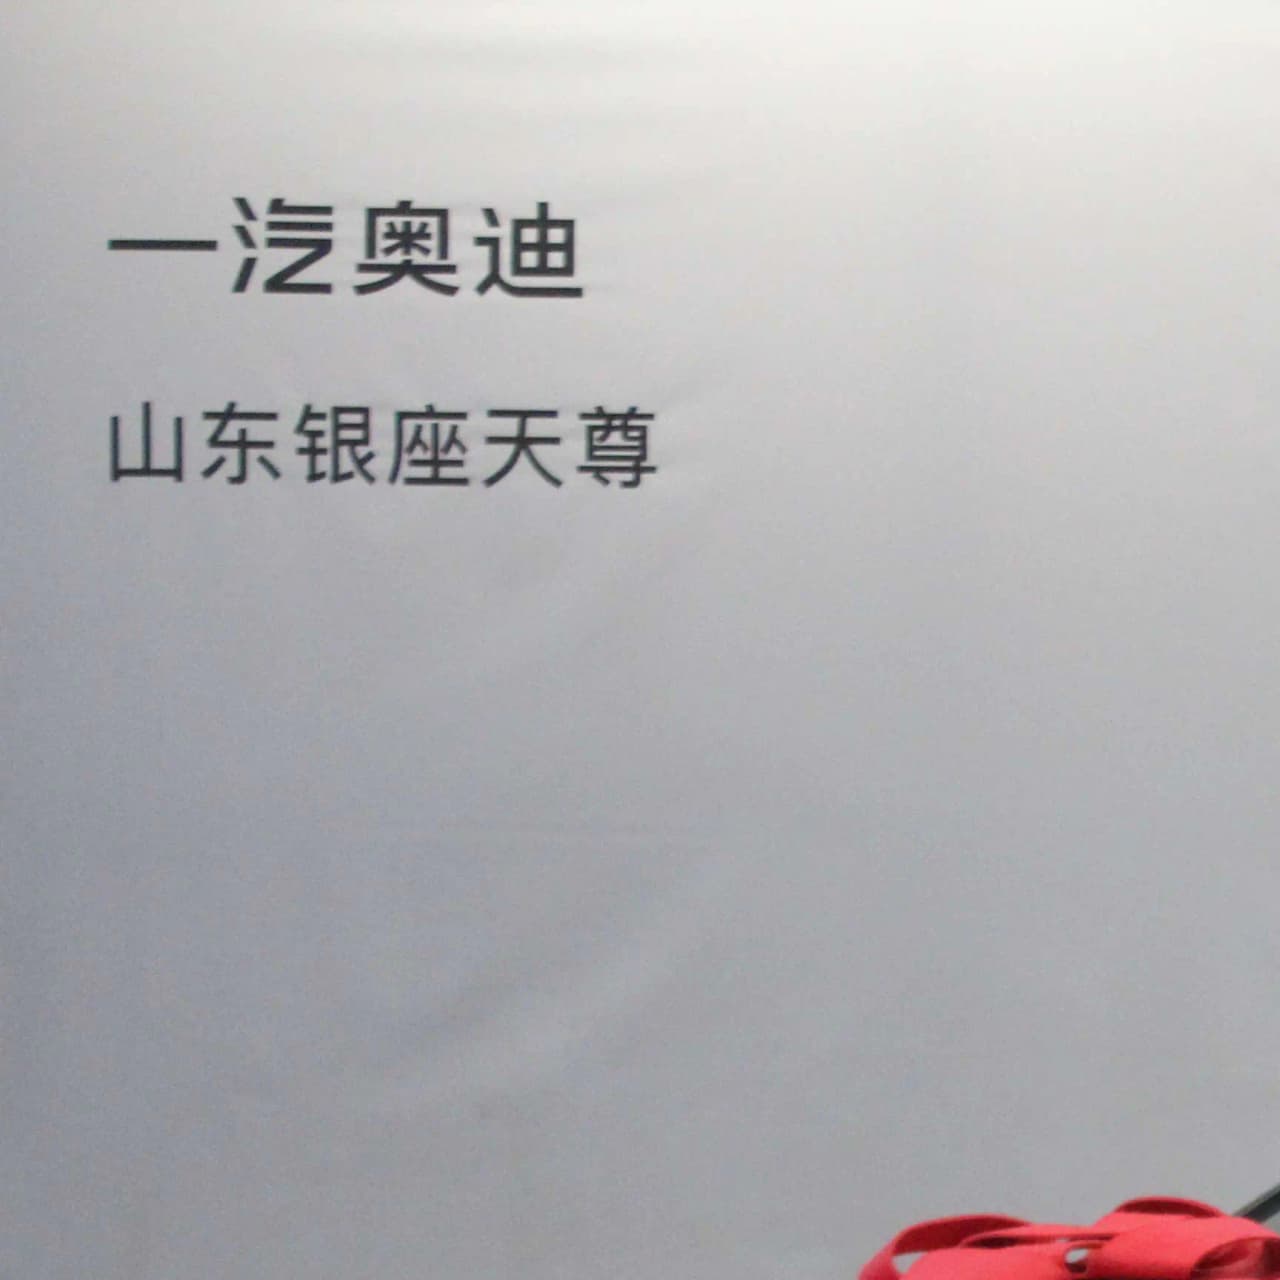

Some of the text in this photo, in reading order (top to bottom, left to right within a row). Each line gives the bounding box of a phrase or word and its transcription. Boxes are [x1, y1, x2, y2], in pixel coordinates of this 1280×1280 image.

[107, 196, 584, 299] 一汽奥迪
[109, 401, 657, 489] 山东银座天尊
